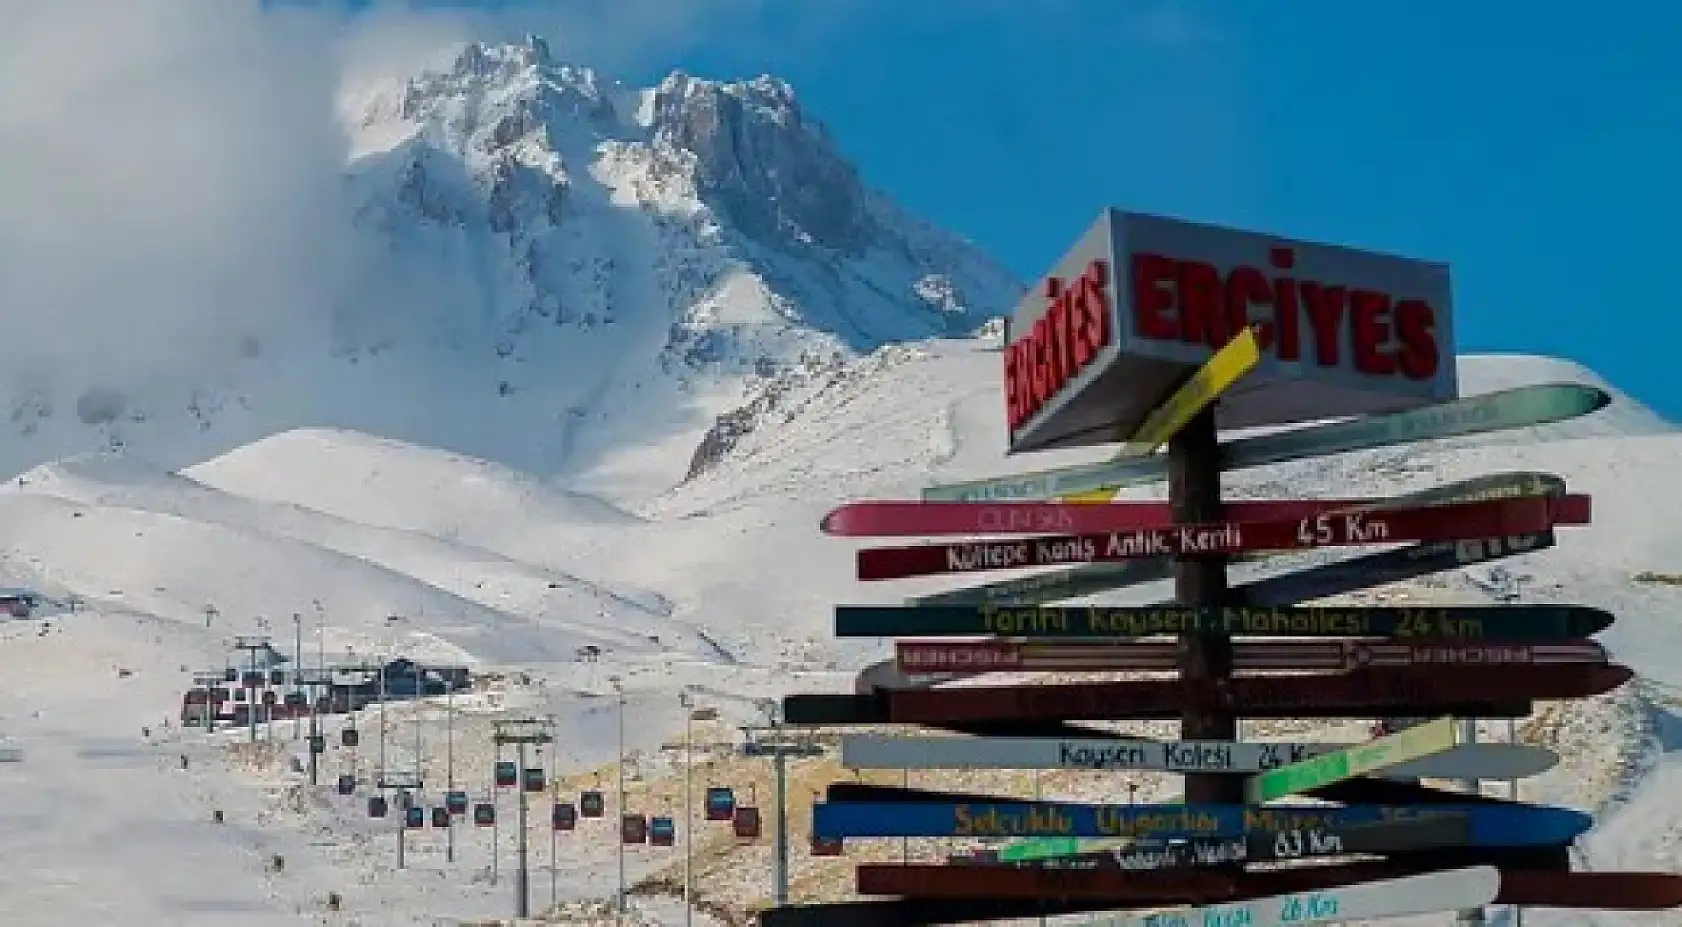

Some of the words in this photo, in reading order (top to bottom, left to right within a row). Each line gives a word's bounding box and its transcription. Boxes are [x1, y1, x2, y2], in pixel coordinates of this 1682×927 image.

[1131, 247, 1440, 381] ERCİYES
[1297, 513, 1334, 546] 45
[1346, 511, 1390, 540] Km
